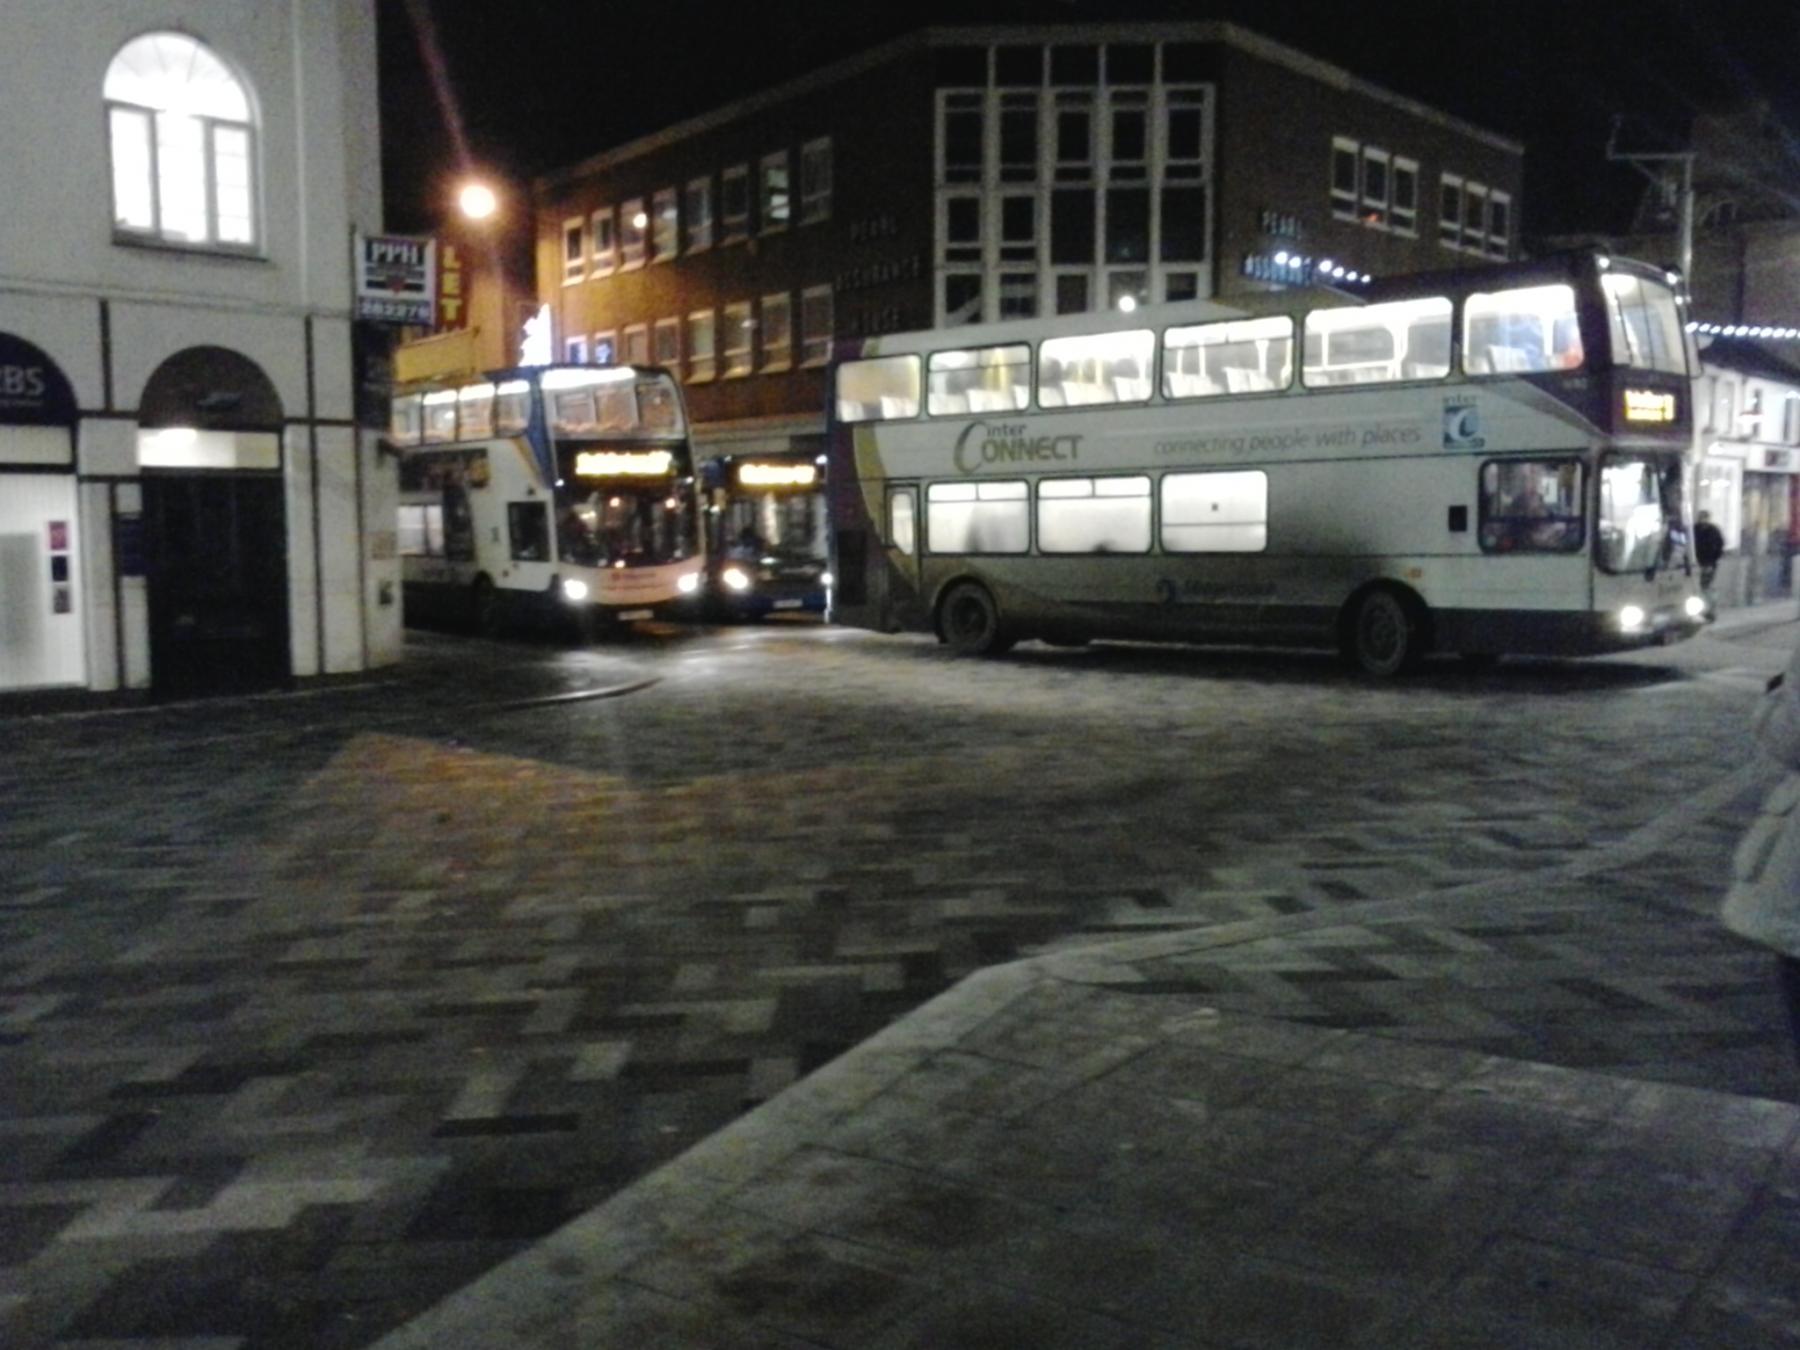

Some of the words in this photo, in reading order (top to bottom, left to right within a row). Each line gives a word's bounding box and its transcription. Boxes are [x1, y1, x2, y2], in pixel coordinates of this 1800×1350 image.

[0, 364, 45, 397] BS
[987, 423, 1027, 437] inter
[1154, 436, 1245, 455] connecting
[1249, 427, 1308, 453] people
[1315, 429, 1356, 447] with
[1361, 422, 1422, 446] places
